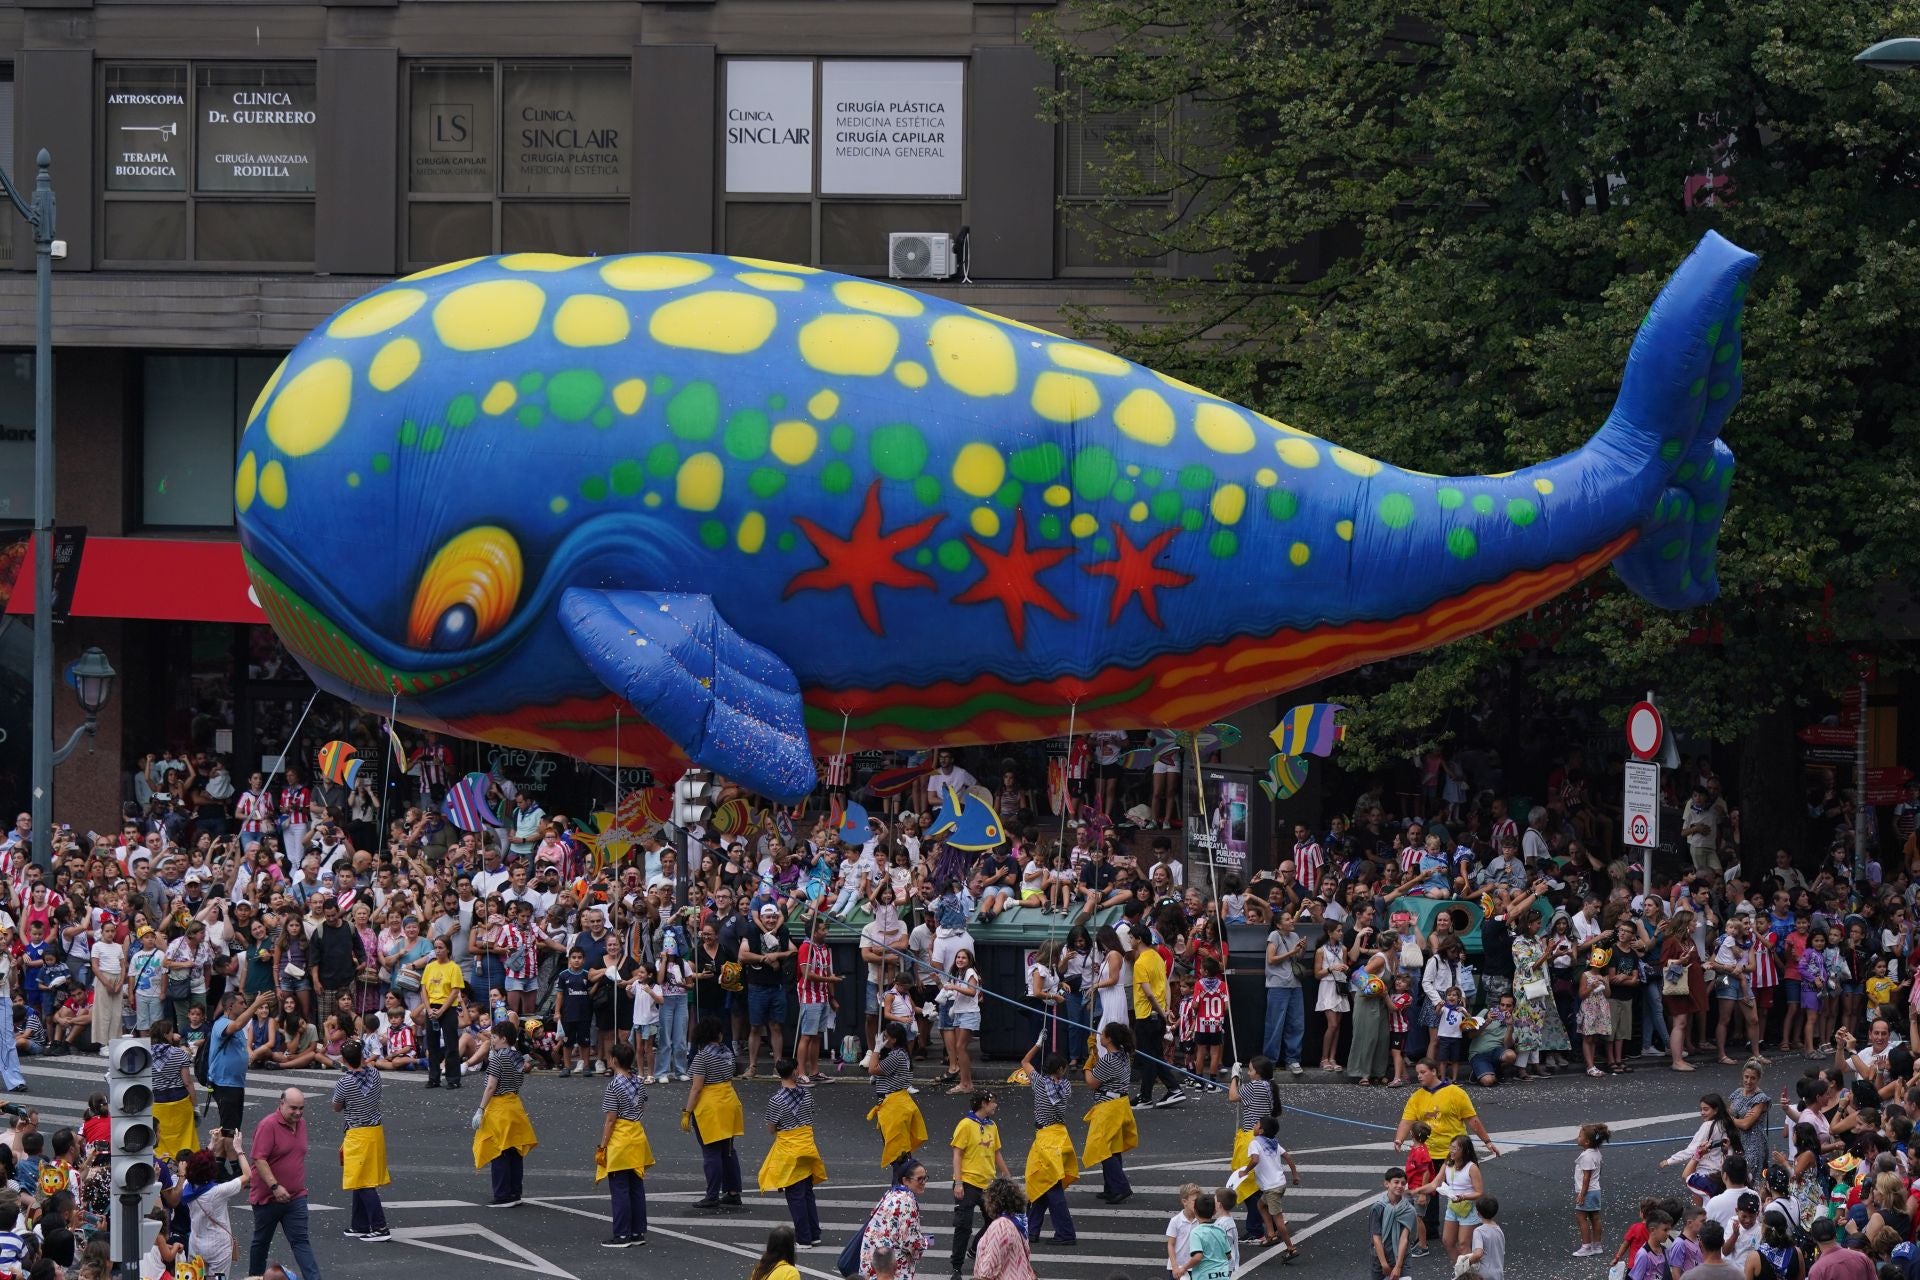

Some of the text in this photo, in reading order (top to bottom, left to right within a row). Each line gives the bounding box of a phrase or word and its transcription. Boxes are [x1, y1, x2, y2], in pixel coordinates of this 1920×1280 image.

[107, 94, 185, 105] ARTROSCOPIA
[233, 92, 291, 105] CLINICA
[836, 100, 945, 113] CIRUGÍA PLÁSTICA
[233, 111, 316, 124] GUERRERO
[836, 116, 945, 128] MEDICINA ESTÉTICA
[437, 115, 467, 142] LS
[522, 129, 618, 149] SINCLAIR
[728, 127, 810, 145] SINCLAIR
[836, 129, 945, 143] CIRUGÍA CAPILAR
[122, 152, 168, 163] TERAPIA
[520, 151, 619, 163] CIRUGÍA PLÁSTICA
[836, 146, 945, 158] MEDICINA GENERAL
[256, 154, 308, 164] AVANZADA
[116, 166, 176, 176] BIOLOGICA
[233, 166, 290, 177] RODILLA
[520, 165, 570, 175] MEDICINA
[618, 769, 652, 784] COF
[1634, 824, 1645, 834] 20
[1216, 850, 1246, 859] PUBLICIDAD
[1203, 996, 1222, 1017] 10
